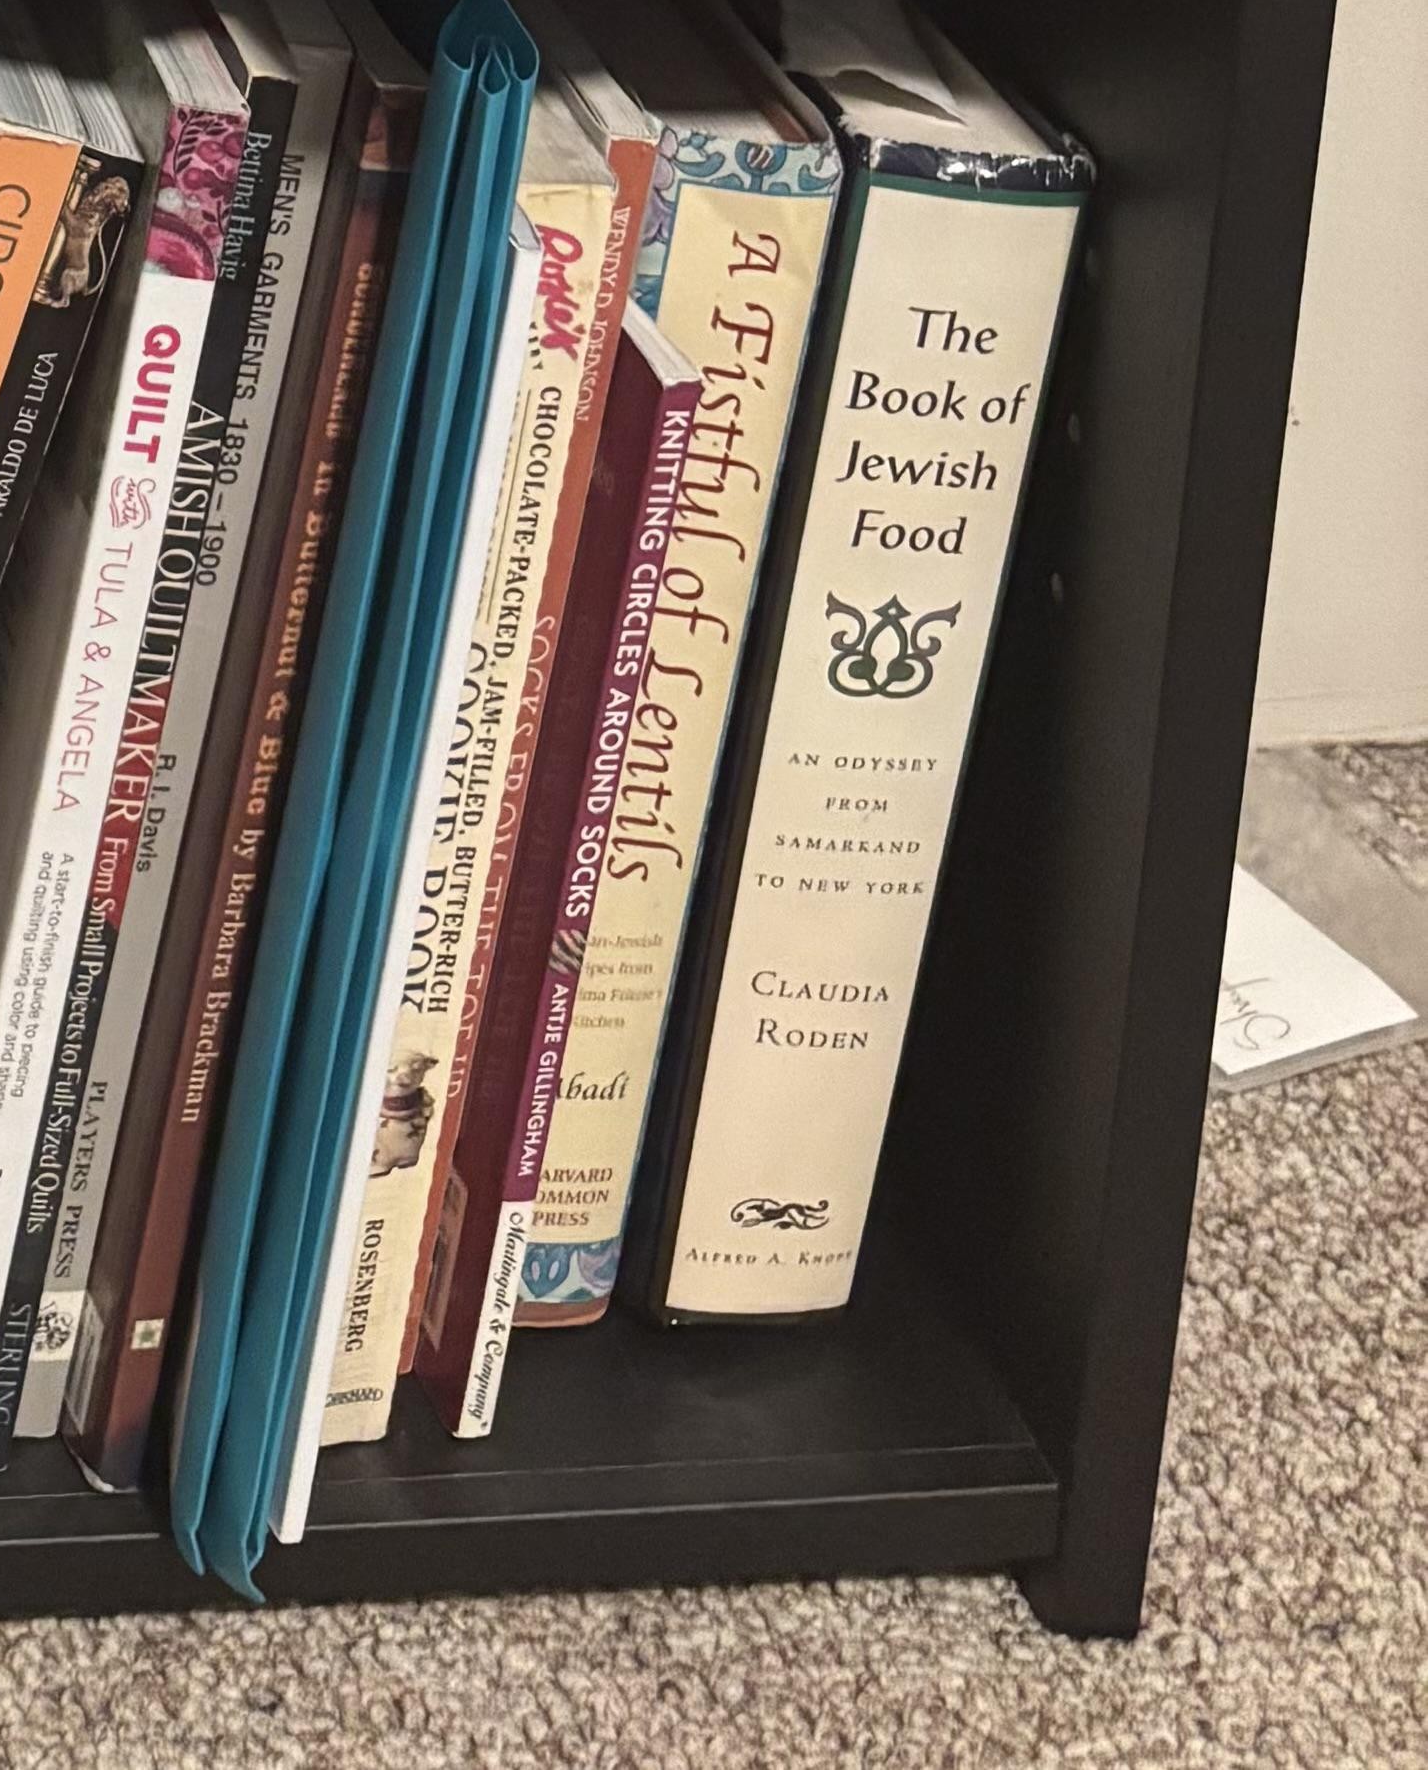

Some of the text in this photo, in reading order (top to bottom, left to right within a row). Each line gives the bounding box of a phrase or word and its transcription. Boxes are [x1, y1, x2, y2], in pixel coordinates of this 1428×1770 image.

[728, 232, 781, 276] A
[123, 325, 181, 463] QUILT
[672, 303, 773, 564] Fistful
[845, 370, 1031, 425] Book of
[836, 440, 999, 491] Jewish
[851, 510, 966, 555] Food
[654, 569, 729, 645] of
[607, 646, 704, 882] Lentils
[518, 984, 569, 1178] ANTJE GILLINGHAM
[53, 1081, 108, 1279] PLAYERS PRESS
[532, 1211, 590, 1226] PRESS
[345, 1219, 384, 1353] ROSENBERG
